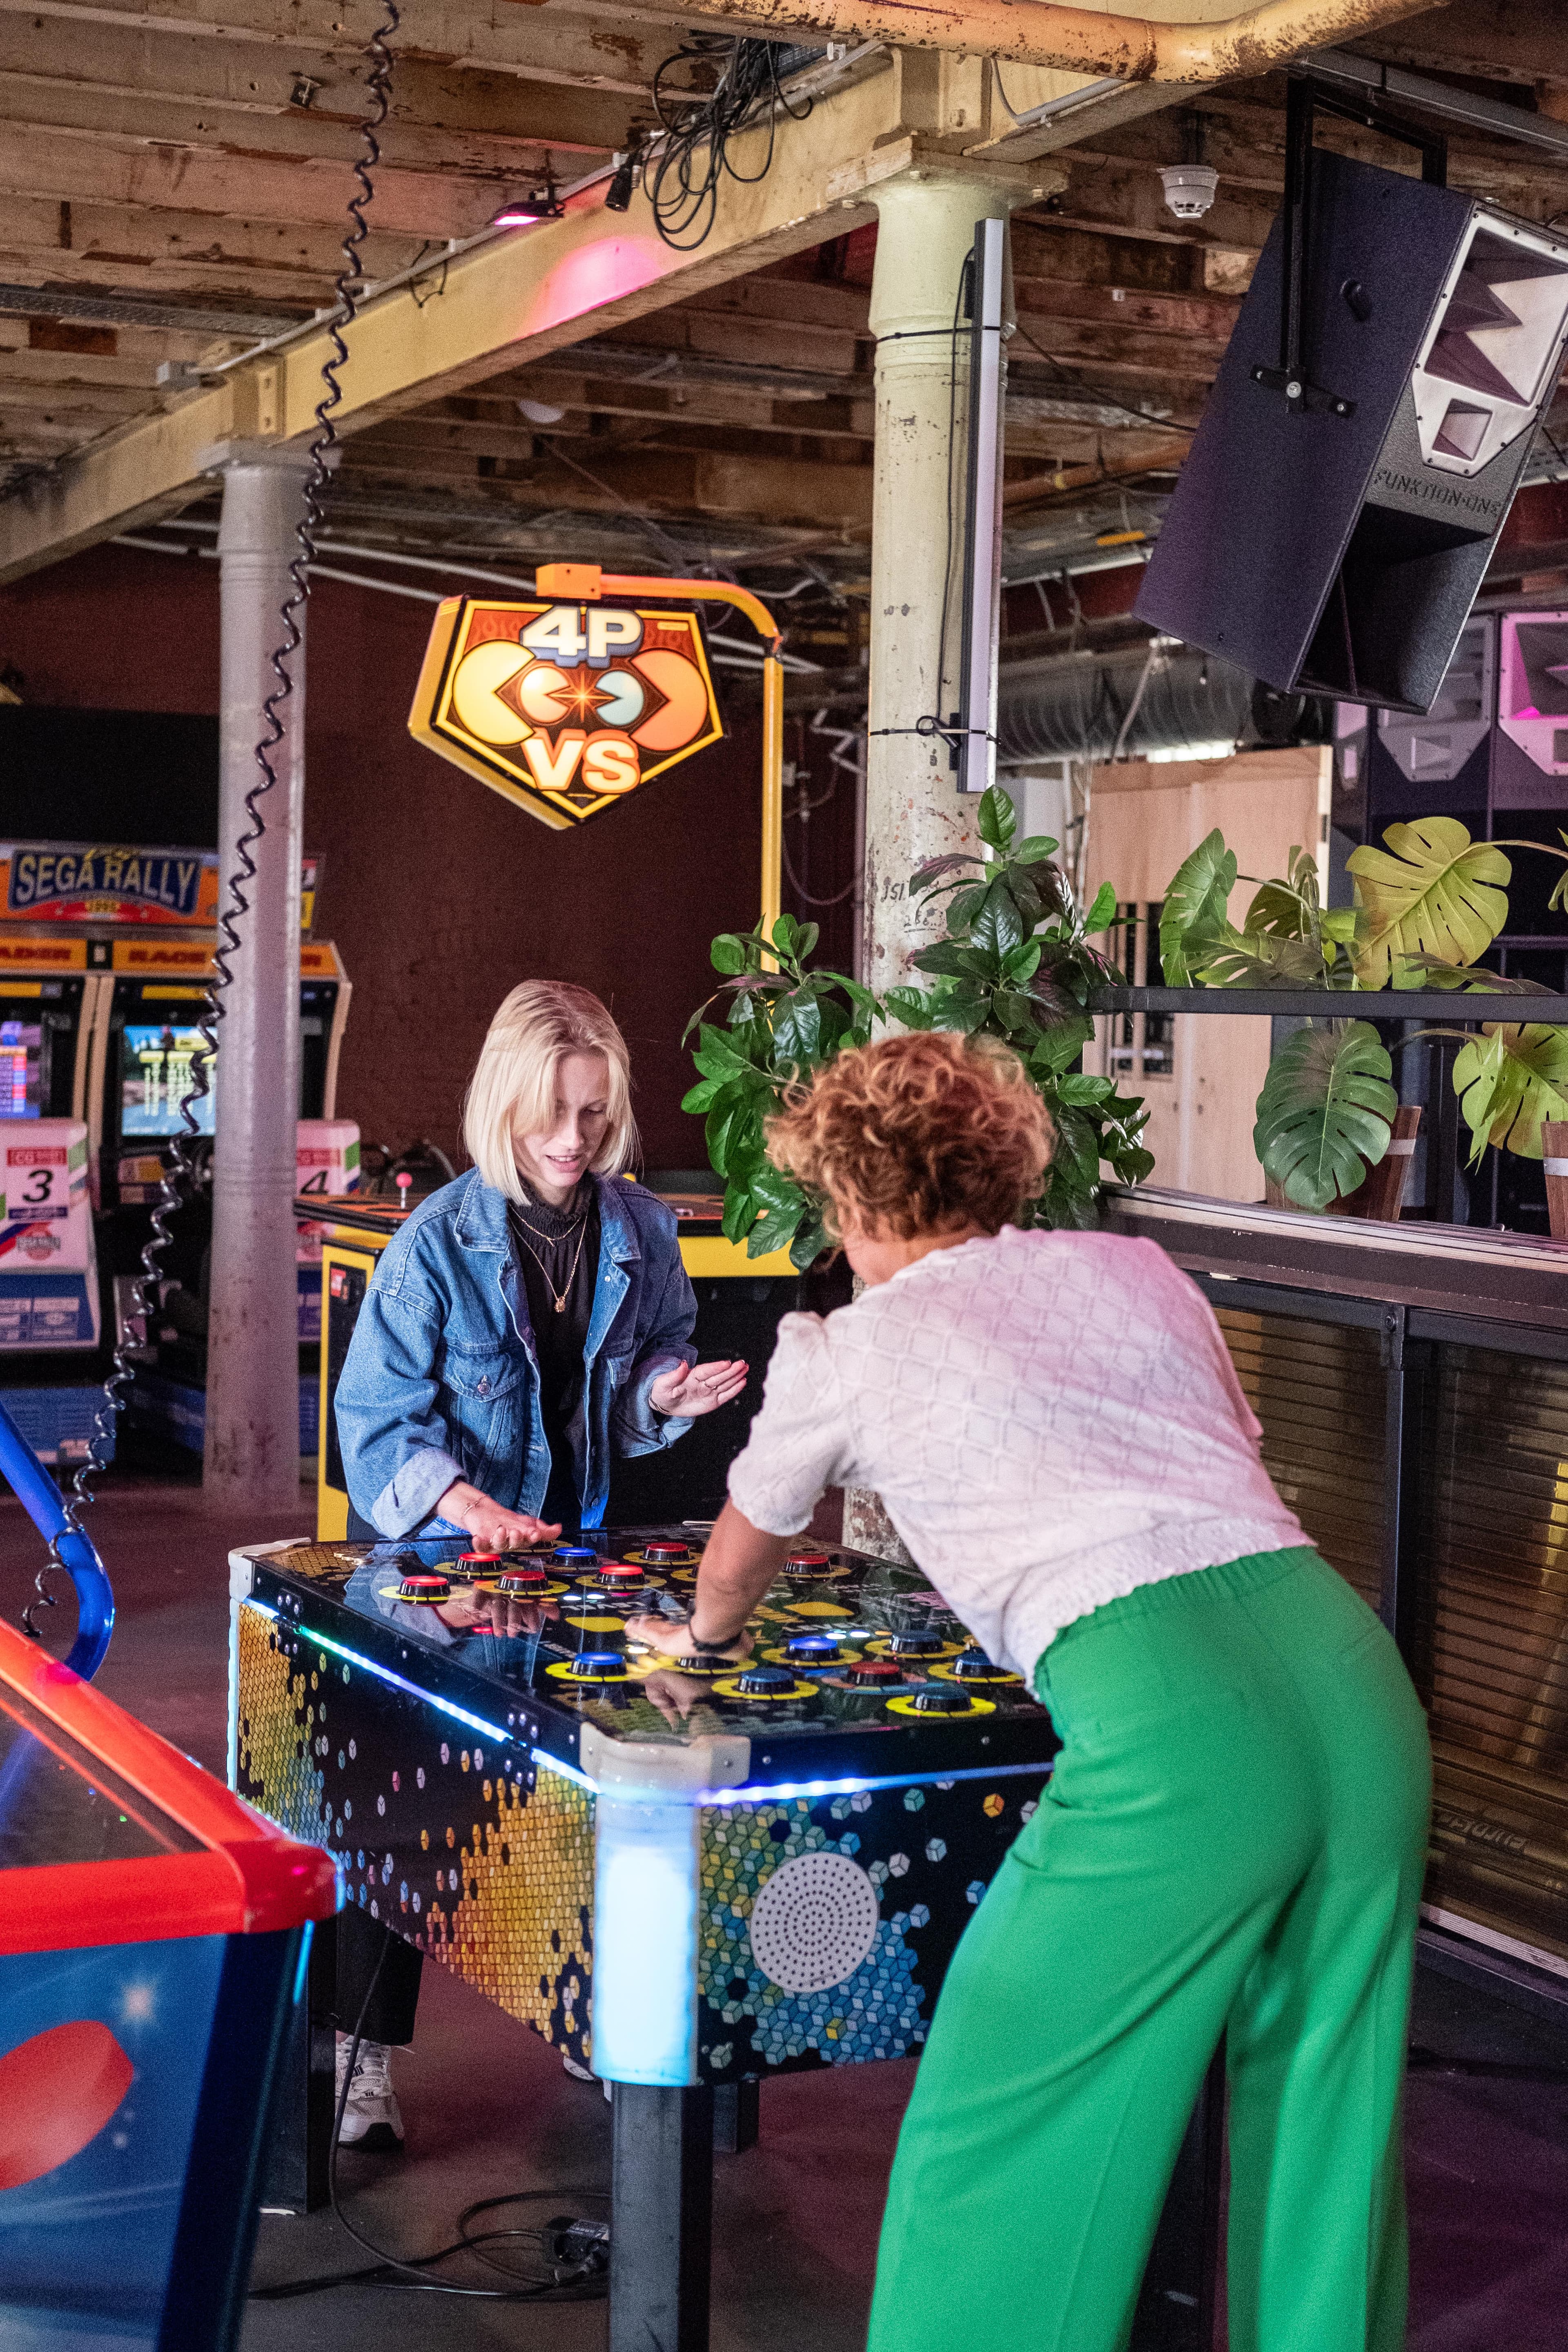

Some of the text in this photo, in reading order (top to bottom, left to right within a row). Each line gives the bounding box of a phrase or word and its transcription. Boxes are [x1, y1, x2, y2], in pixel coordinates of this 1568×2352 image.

[521, 606, 642, 666] 4P
[524, 732, 640, 793] VS
[16, 853, 197, 908] SEGA RALLY
[22, 1169, 53, 1203] 3
[300, 1170, 328, 1195] 4
